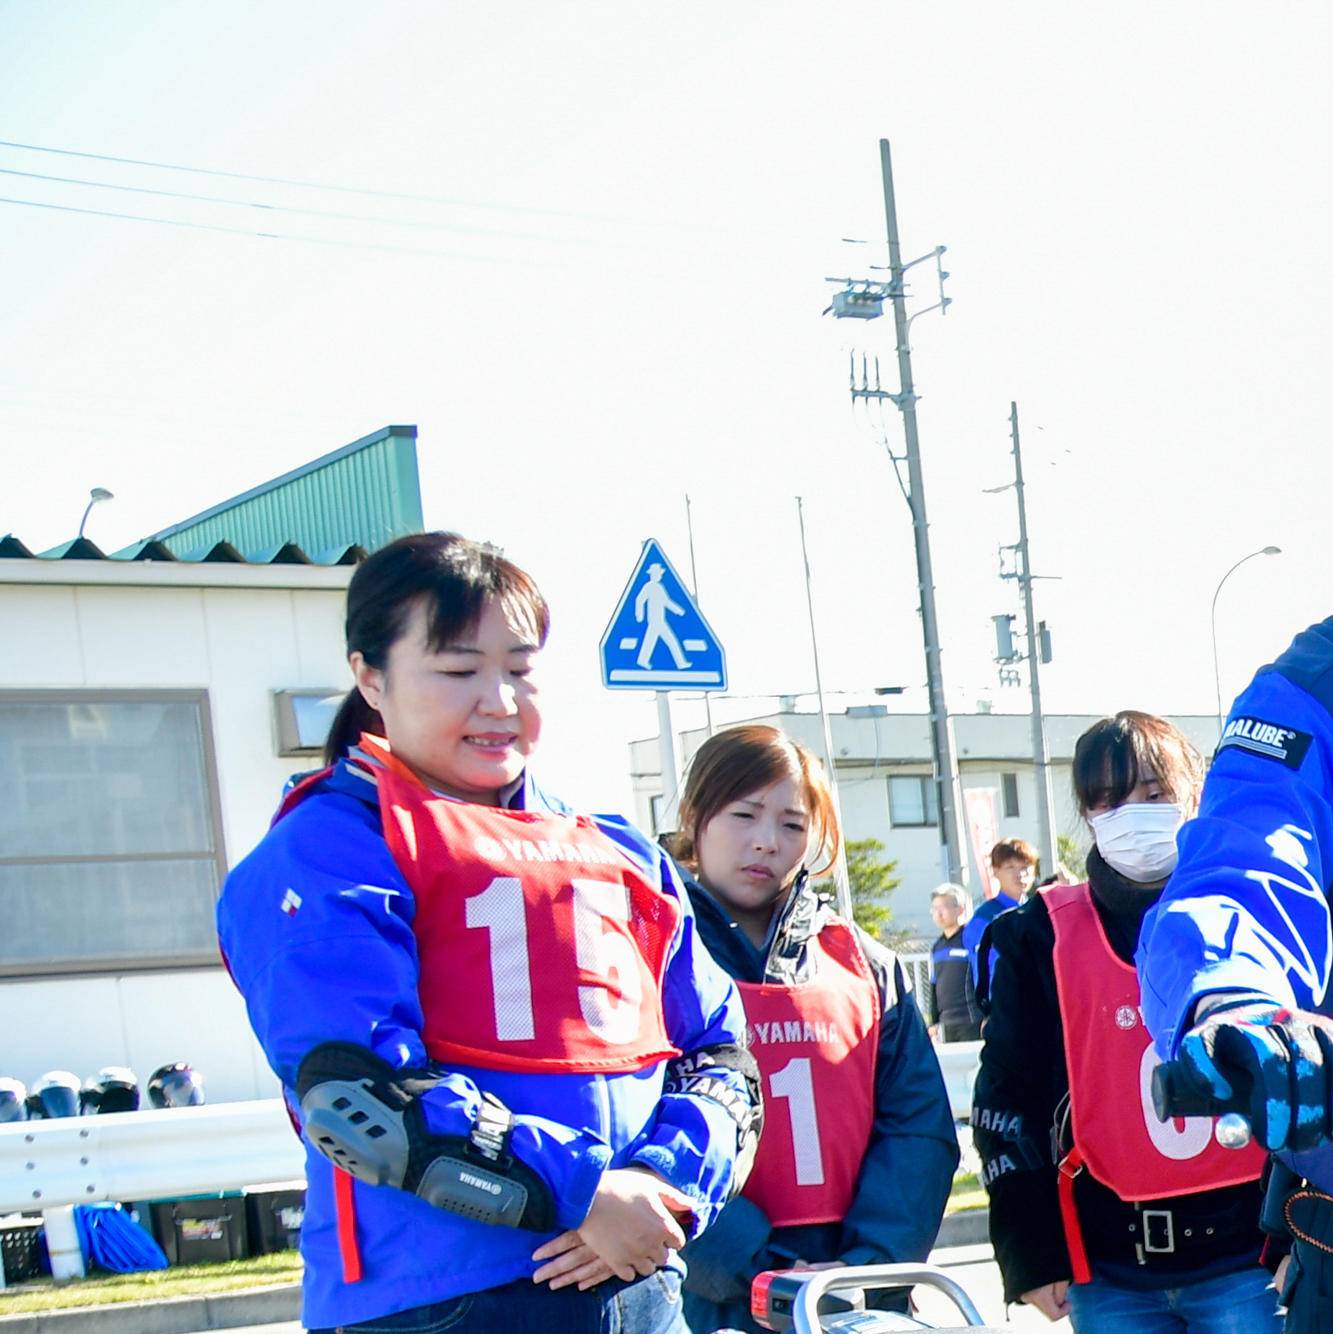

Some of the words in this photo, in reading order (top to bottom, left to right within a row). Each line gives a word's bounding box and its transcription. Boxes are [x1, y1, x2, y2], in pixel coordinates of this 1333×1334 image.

[501, 839, 617, 865] YAMAHA
[465, 877, 643, 1045] 15
[754, 1020, 840, 1045] YAMAHA
[769, 1057, 825, 1186] 1
